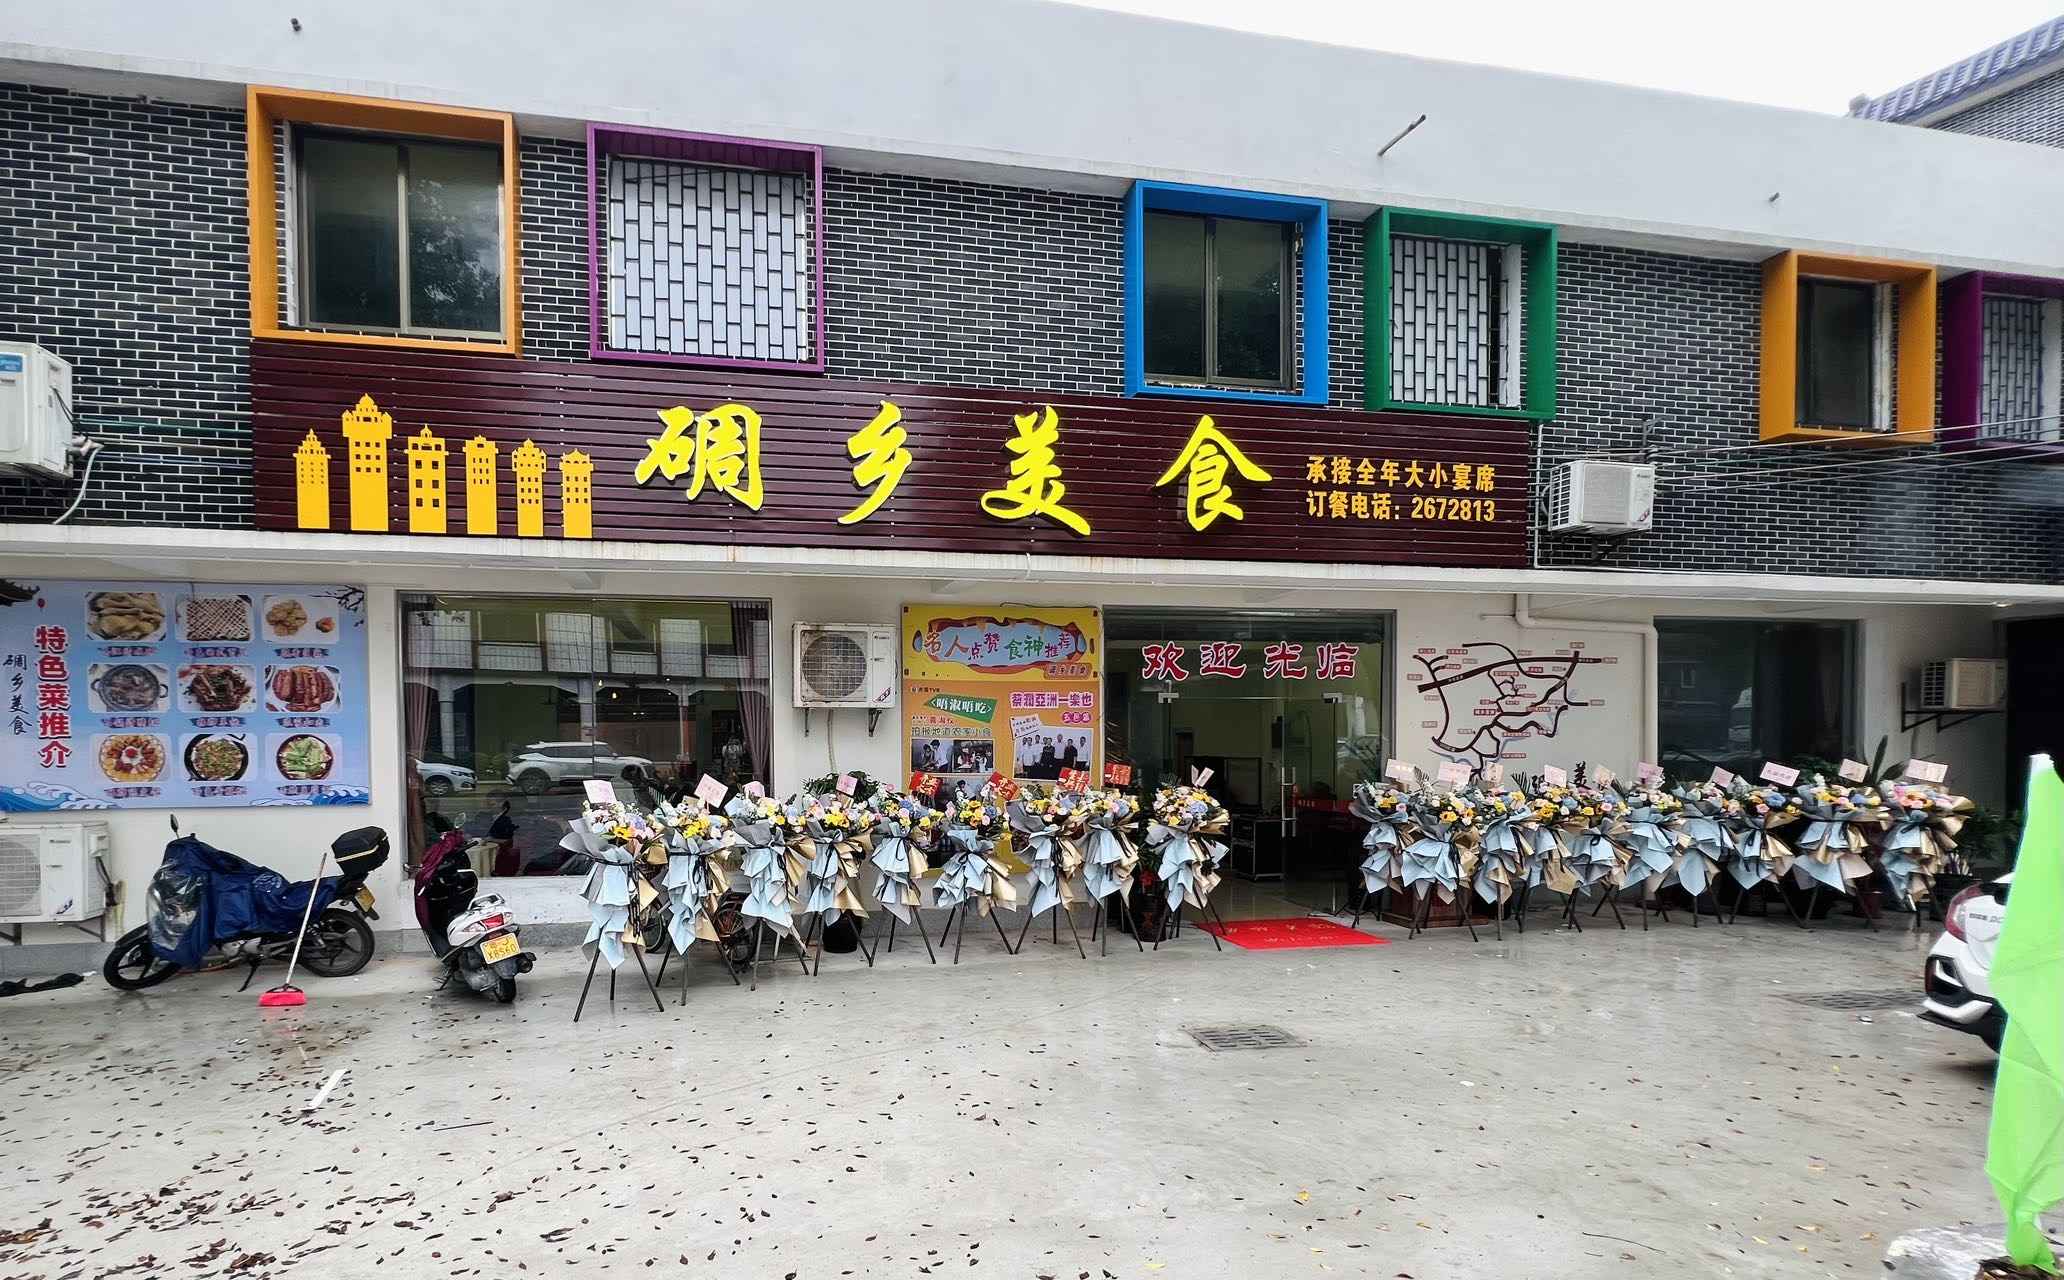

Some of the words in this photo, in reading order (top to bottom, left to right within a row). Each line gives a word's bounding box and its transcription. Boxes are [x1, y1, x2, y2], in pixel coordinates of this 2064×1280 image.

[634, 401, 1273, 536] 碉乡美食
[1306, 455, 1495, 492] 承接全年大小宴席
[3, 653, 32, 735] 碉乡美食
[35, 625, 71, 767] 特色菜推介
[1142, 640, 1359, 681] 欢迎光临
